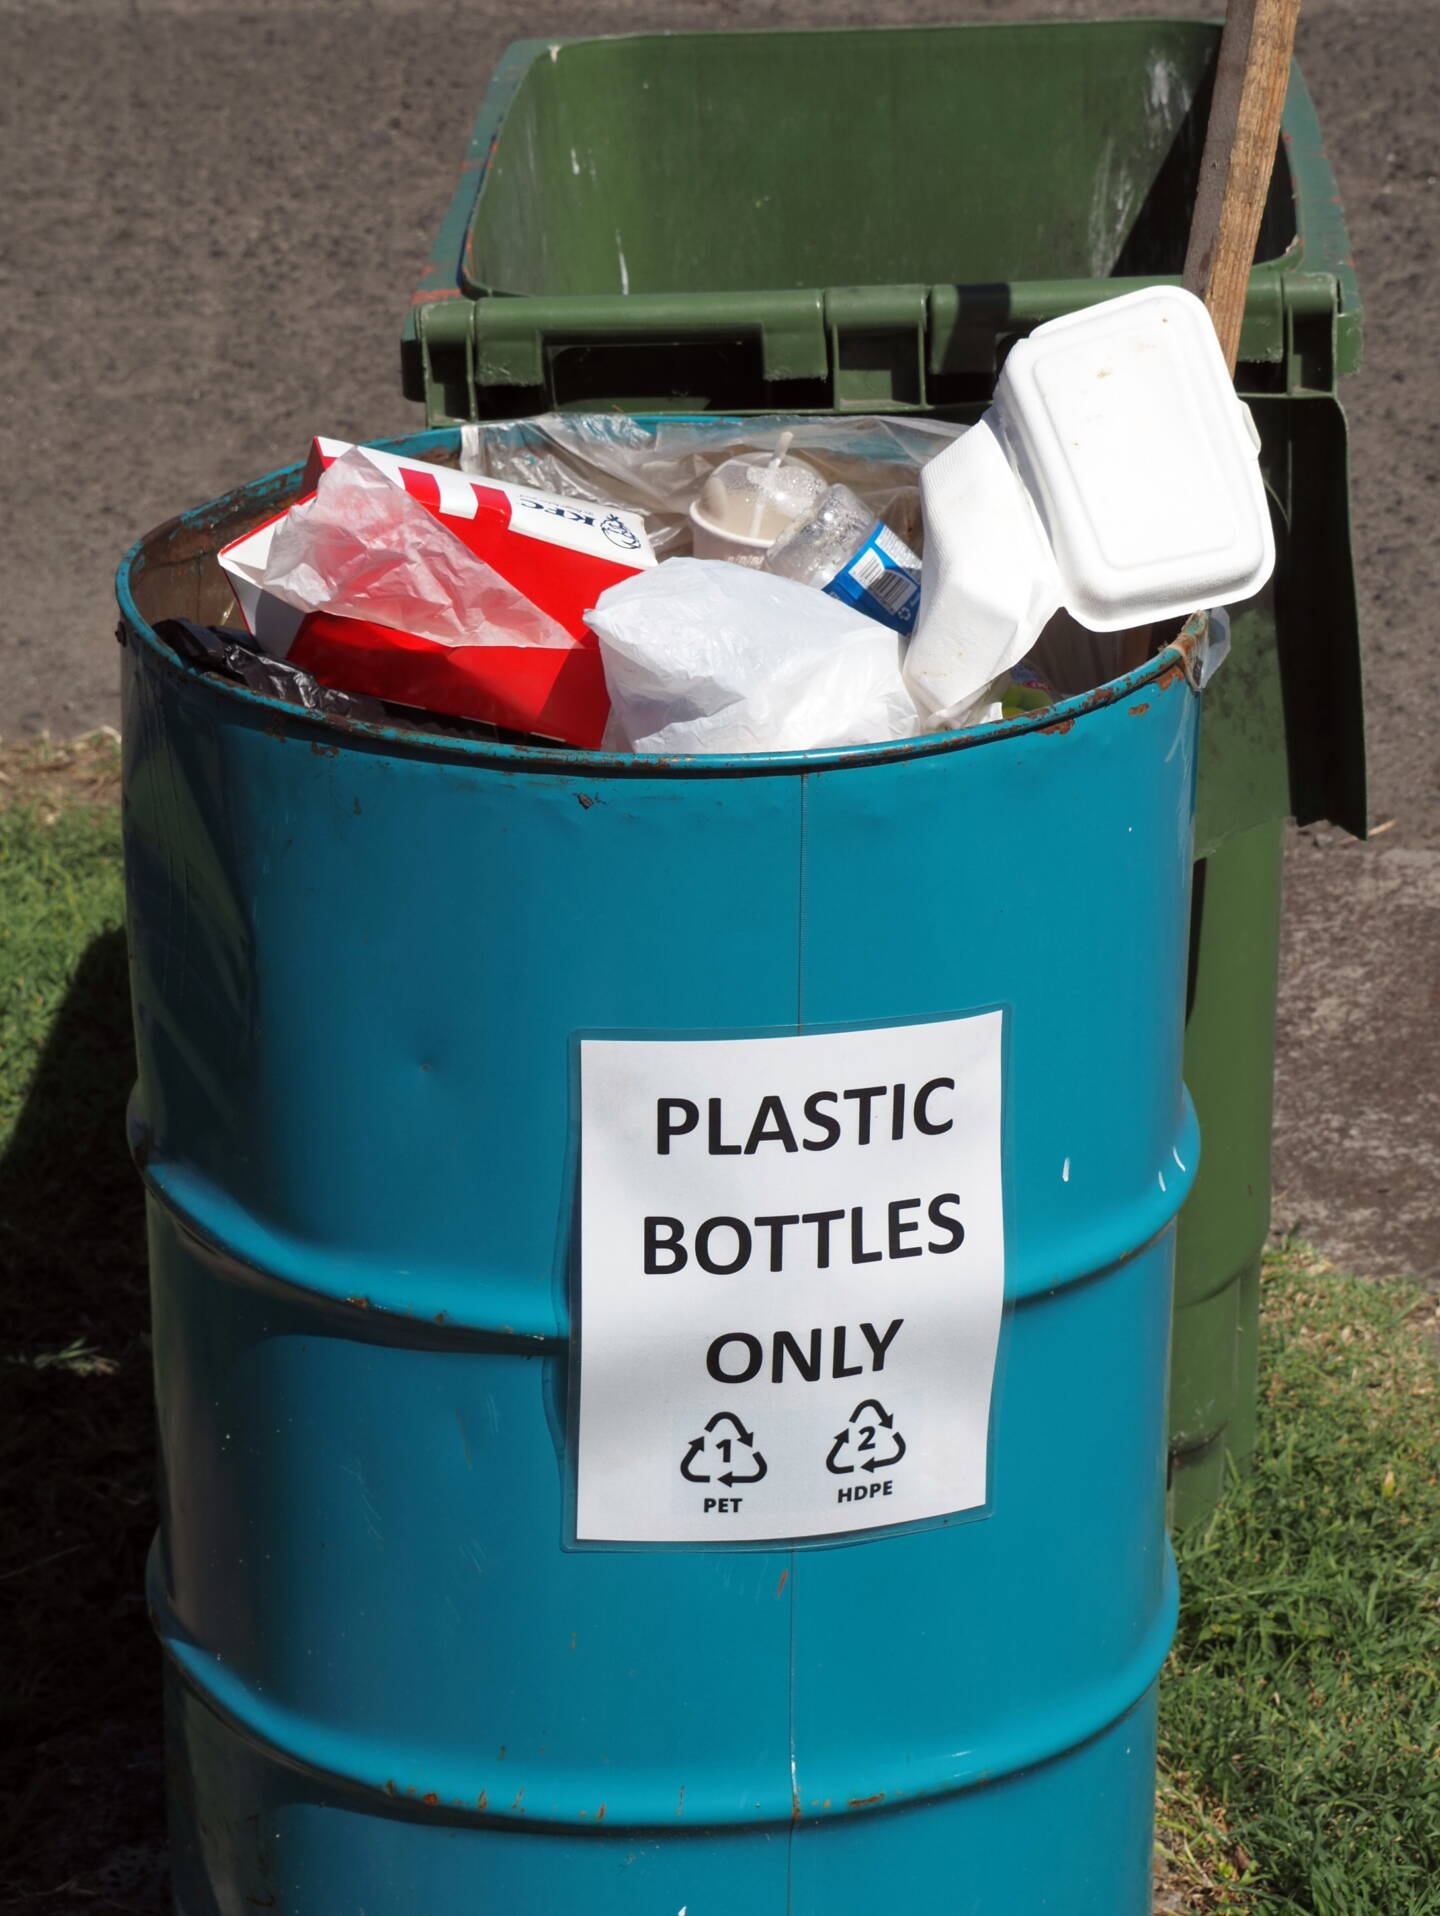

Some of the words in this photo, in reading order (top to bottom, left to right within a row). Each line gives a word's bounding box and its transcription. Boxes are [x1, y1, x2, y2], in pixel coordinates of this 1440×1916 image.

[520, 498, 595, 526] KFC
[656, 1077, 955, 1156] PLASTIC
[643, 1193, 965, 1276] BOTTLES
[705, 1318, 905, 1384] ONLY
[715, 1438, 732, 1463] 1
[857, 1426, 876, 1452] 2
[703, 1497, 743, 1513] PET
[837, 1480, 893, 1504] HDPE
